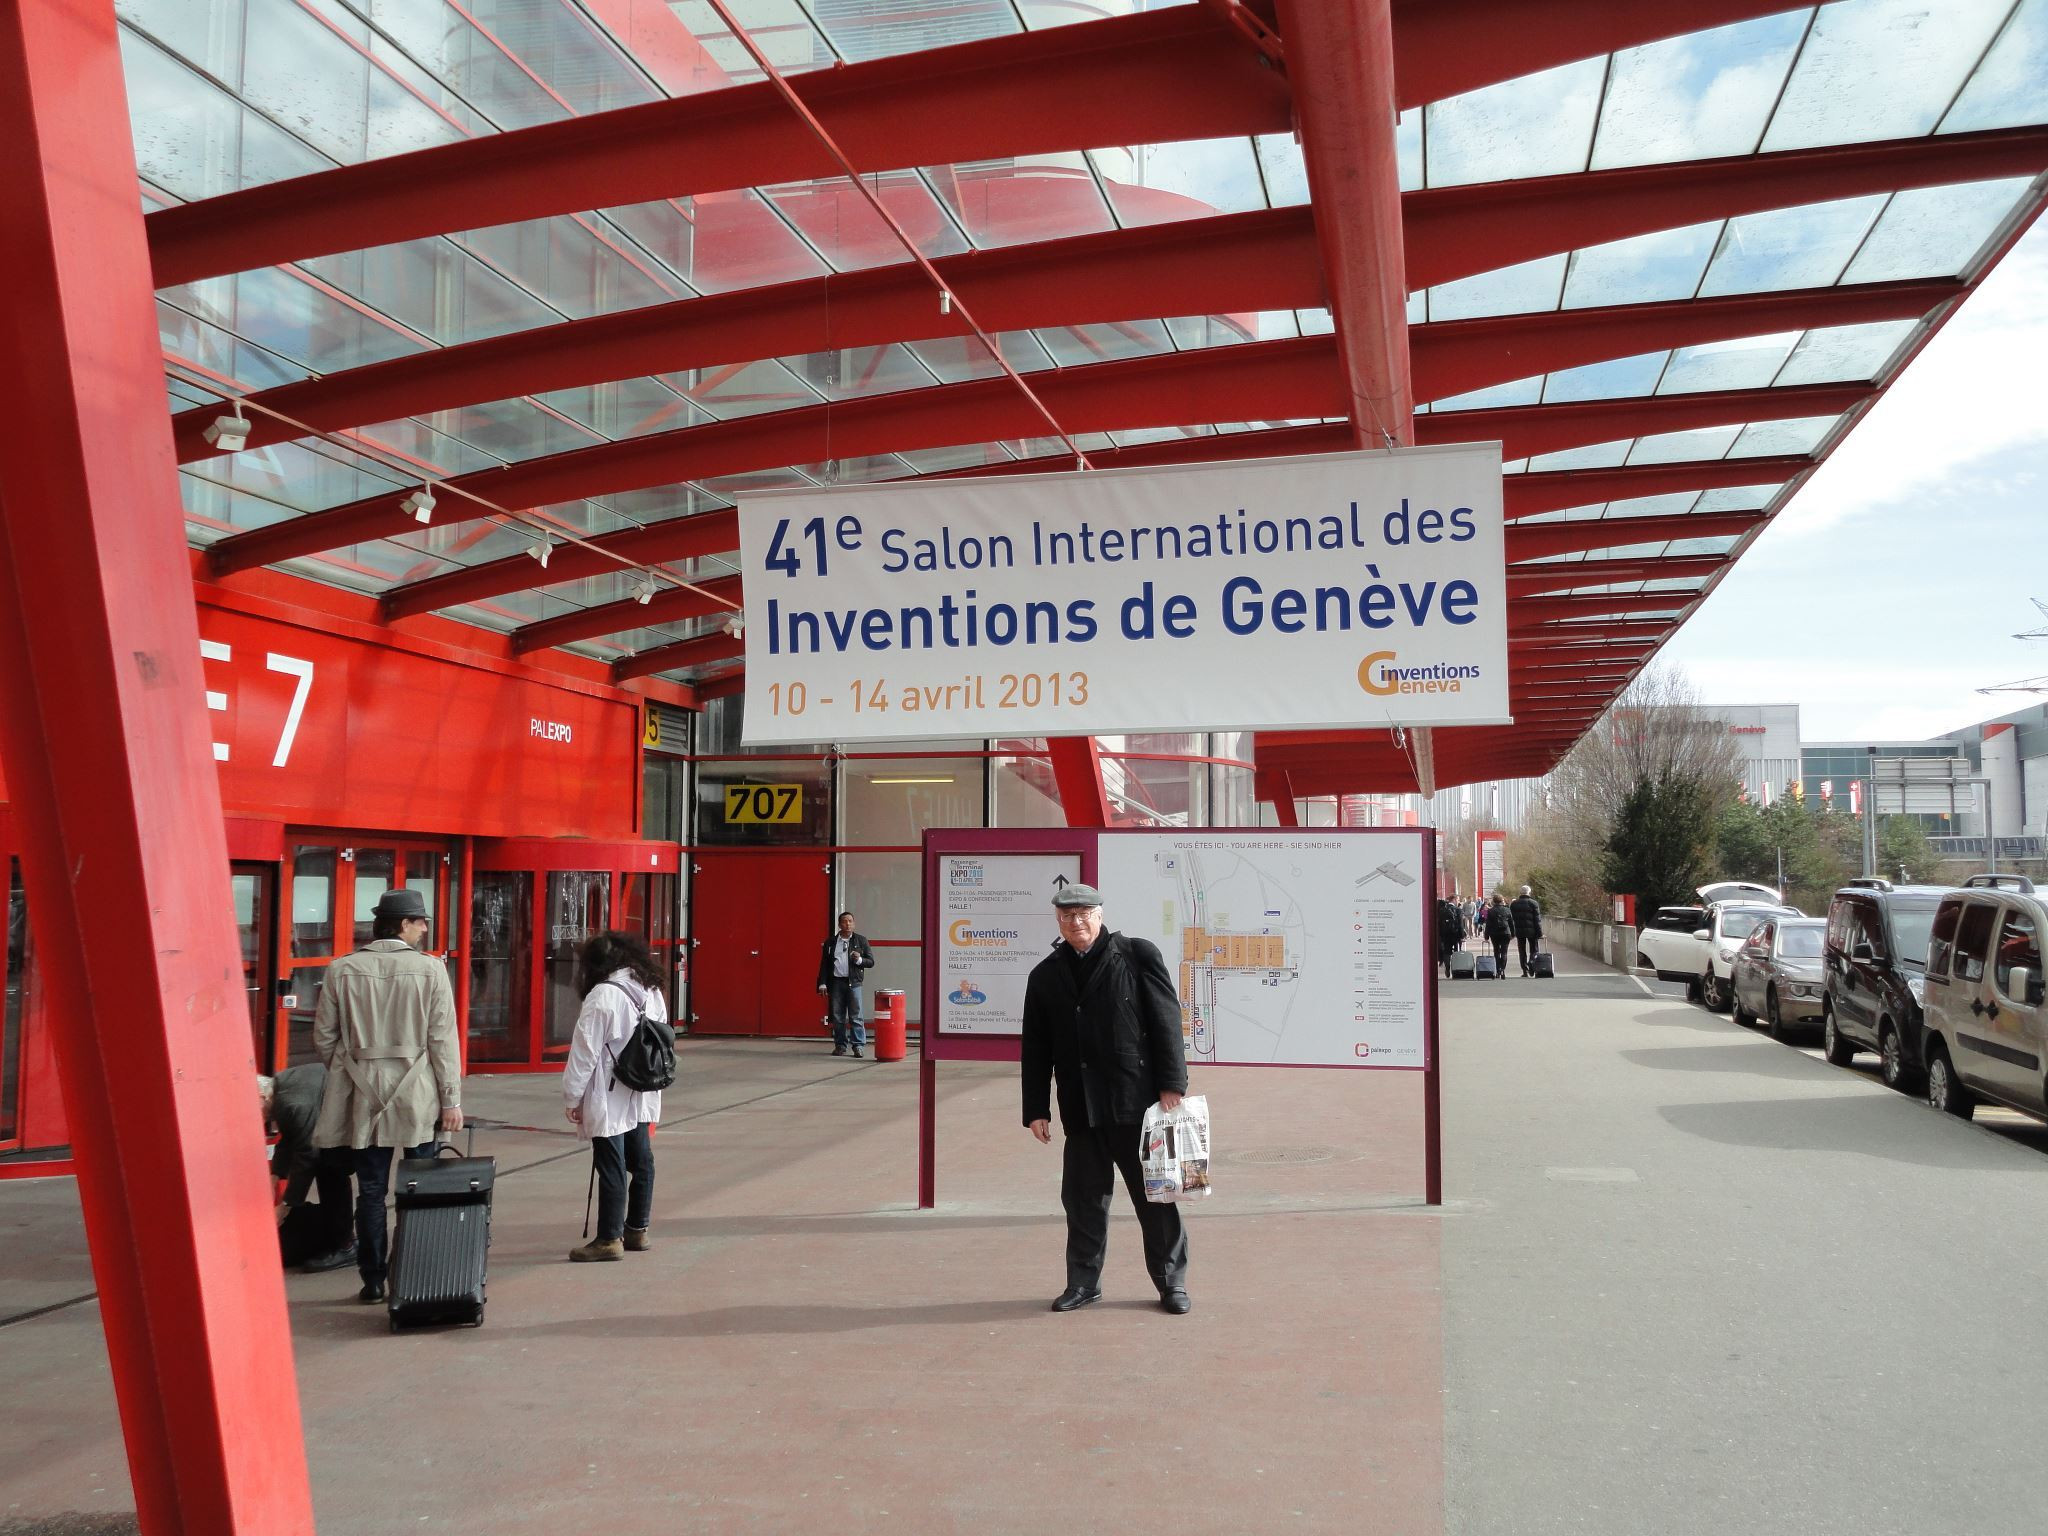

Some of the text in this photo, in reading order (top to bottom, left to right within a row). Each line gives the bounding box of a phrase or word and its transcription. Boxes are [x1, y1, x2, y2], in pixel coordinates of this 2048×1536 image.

[765, 498, 1477, 578] 41e Salon International des
[767, 563, 1479, 654] Inventions de Genève
[1357, 650, 1461, 696] Geneva
[1380, 662, 1480, 682] inventions
[768, 681, 807, 716] 10
[850, 678, 889, 713] 14
[901, 675, 985, 712] avril
[998, 671, 1089, 708] 2013
[266, 652, 314, 768] 7
[530, 718, 572, 744] PALEXPO
[1728, 725, 1767, 735] Genève
[729, 787, 798, 820] 707
[1173, 842, 1193, 850] VOUS
[1194, 840, 1213, 850] ÊTES
[1214, 842, 1224, 850] ICI
[1231, 842, 1246, 850] YOU
[1247, 842, 1262, 850] ARE
[1263, 842, 1284, 850] HERE
[1290, 842, 1302, 850] SIE
[1304, 842, 1322, 850] SIND
[1324, 842, 1342, 850] HIER
[950, 870, 968, 878] EXPO
[948, 920, 1008, 947] Geneva
[962, 928, 1018, 938] inventions
